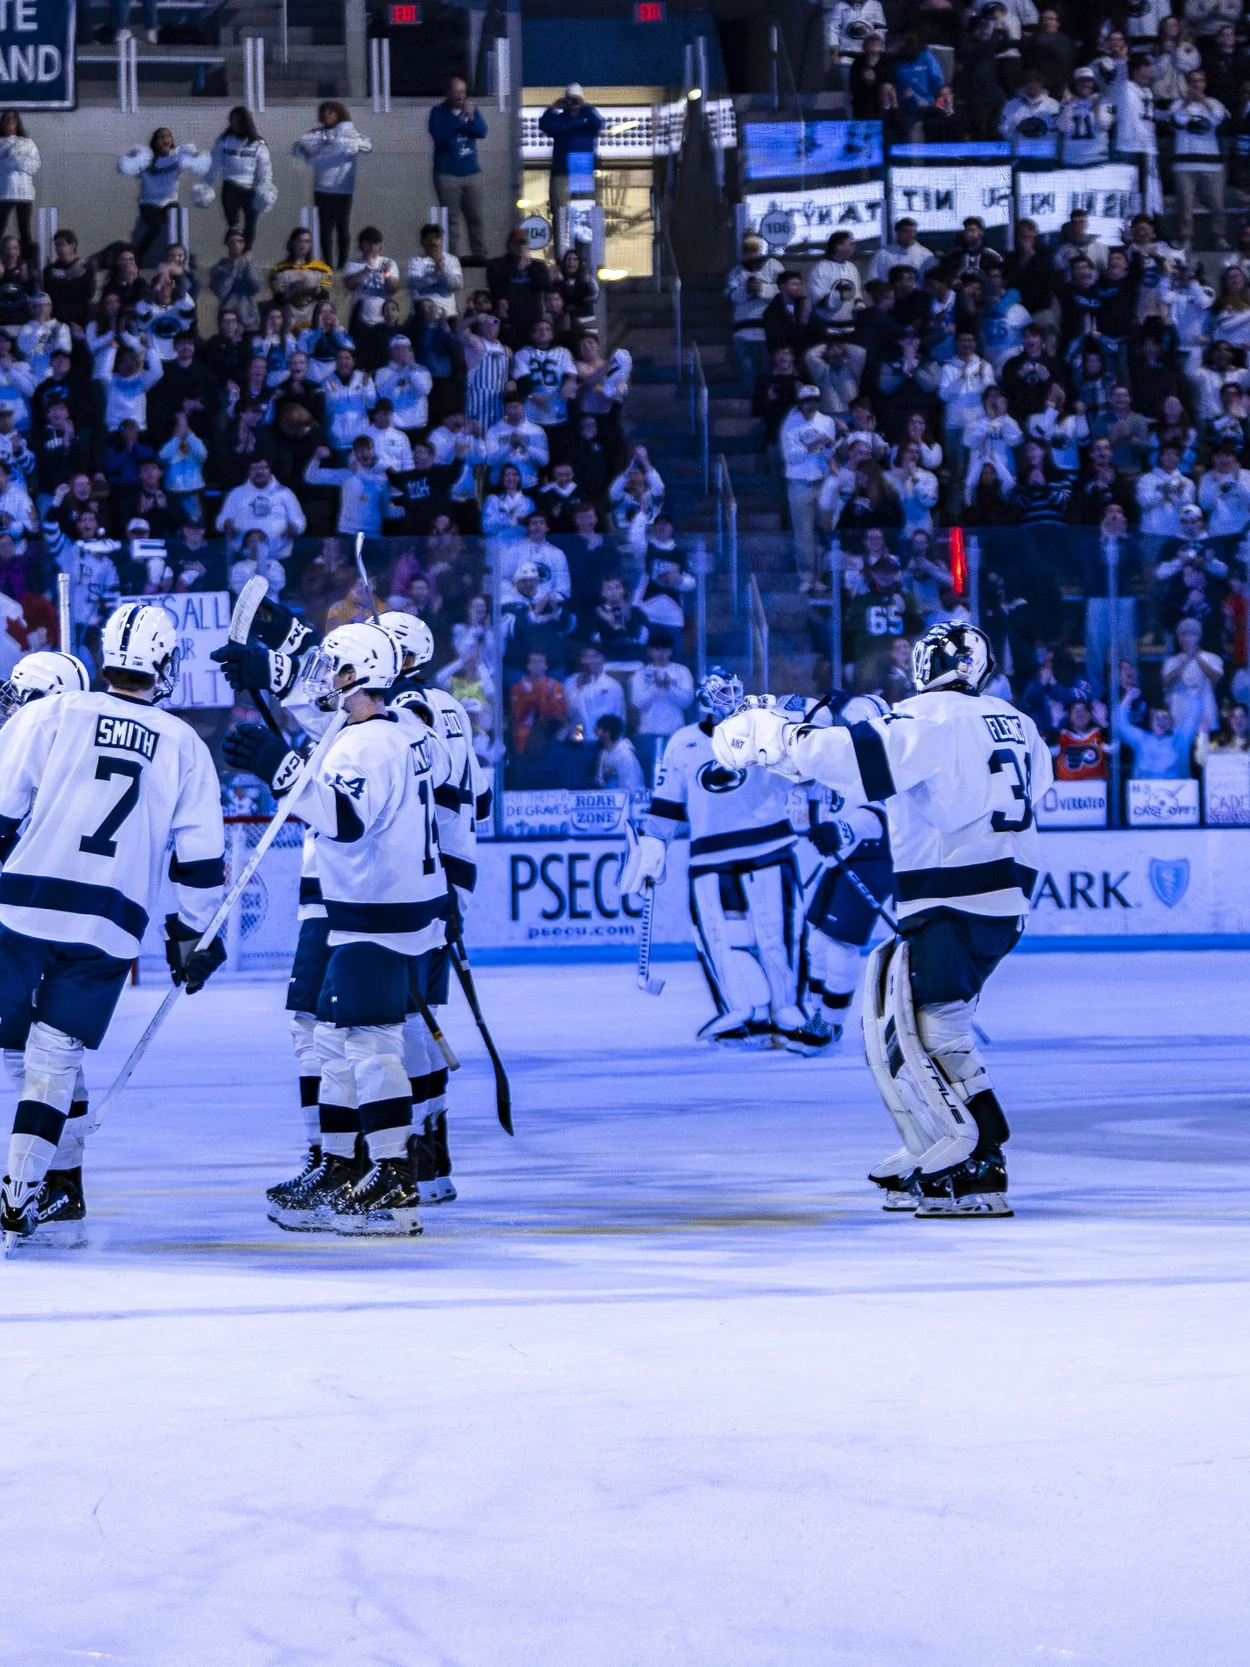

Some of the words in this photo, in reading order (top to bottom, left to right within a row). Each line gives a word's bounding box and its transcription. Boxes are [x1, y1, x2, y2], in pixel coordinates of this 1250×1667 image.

[393, 5, 417, 22] EXIT
[638, 3, 662, 21] EXIT
[179, 594, 230, 630] ALL
[97, 718, 156, 758] SMITH
[79, 755, 144, 858] 7
[575, 795, 617, 807] ROAR
[576, 812, 616, 824] ZONE
[528, 924, 636, 940] psecu.com
[37, 1194, 70, 1221] CCM
